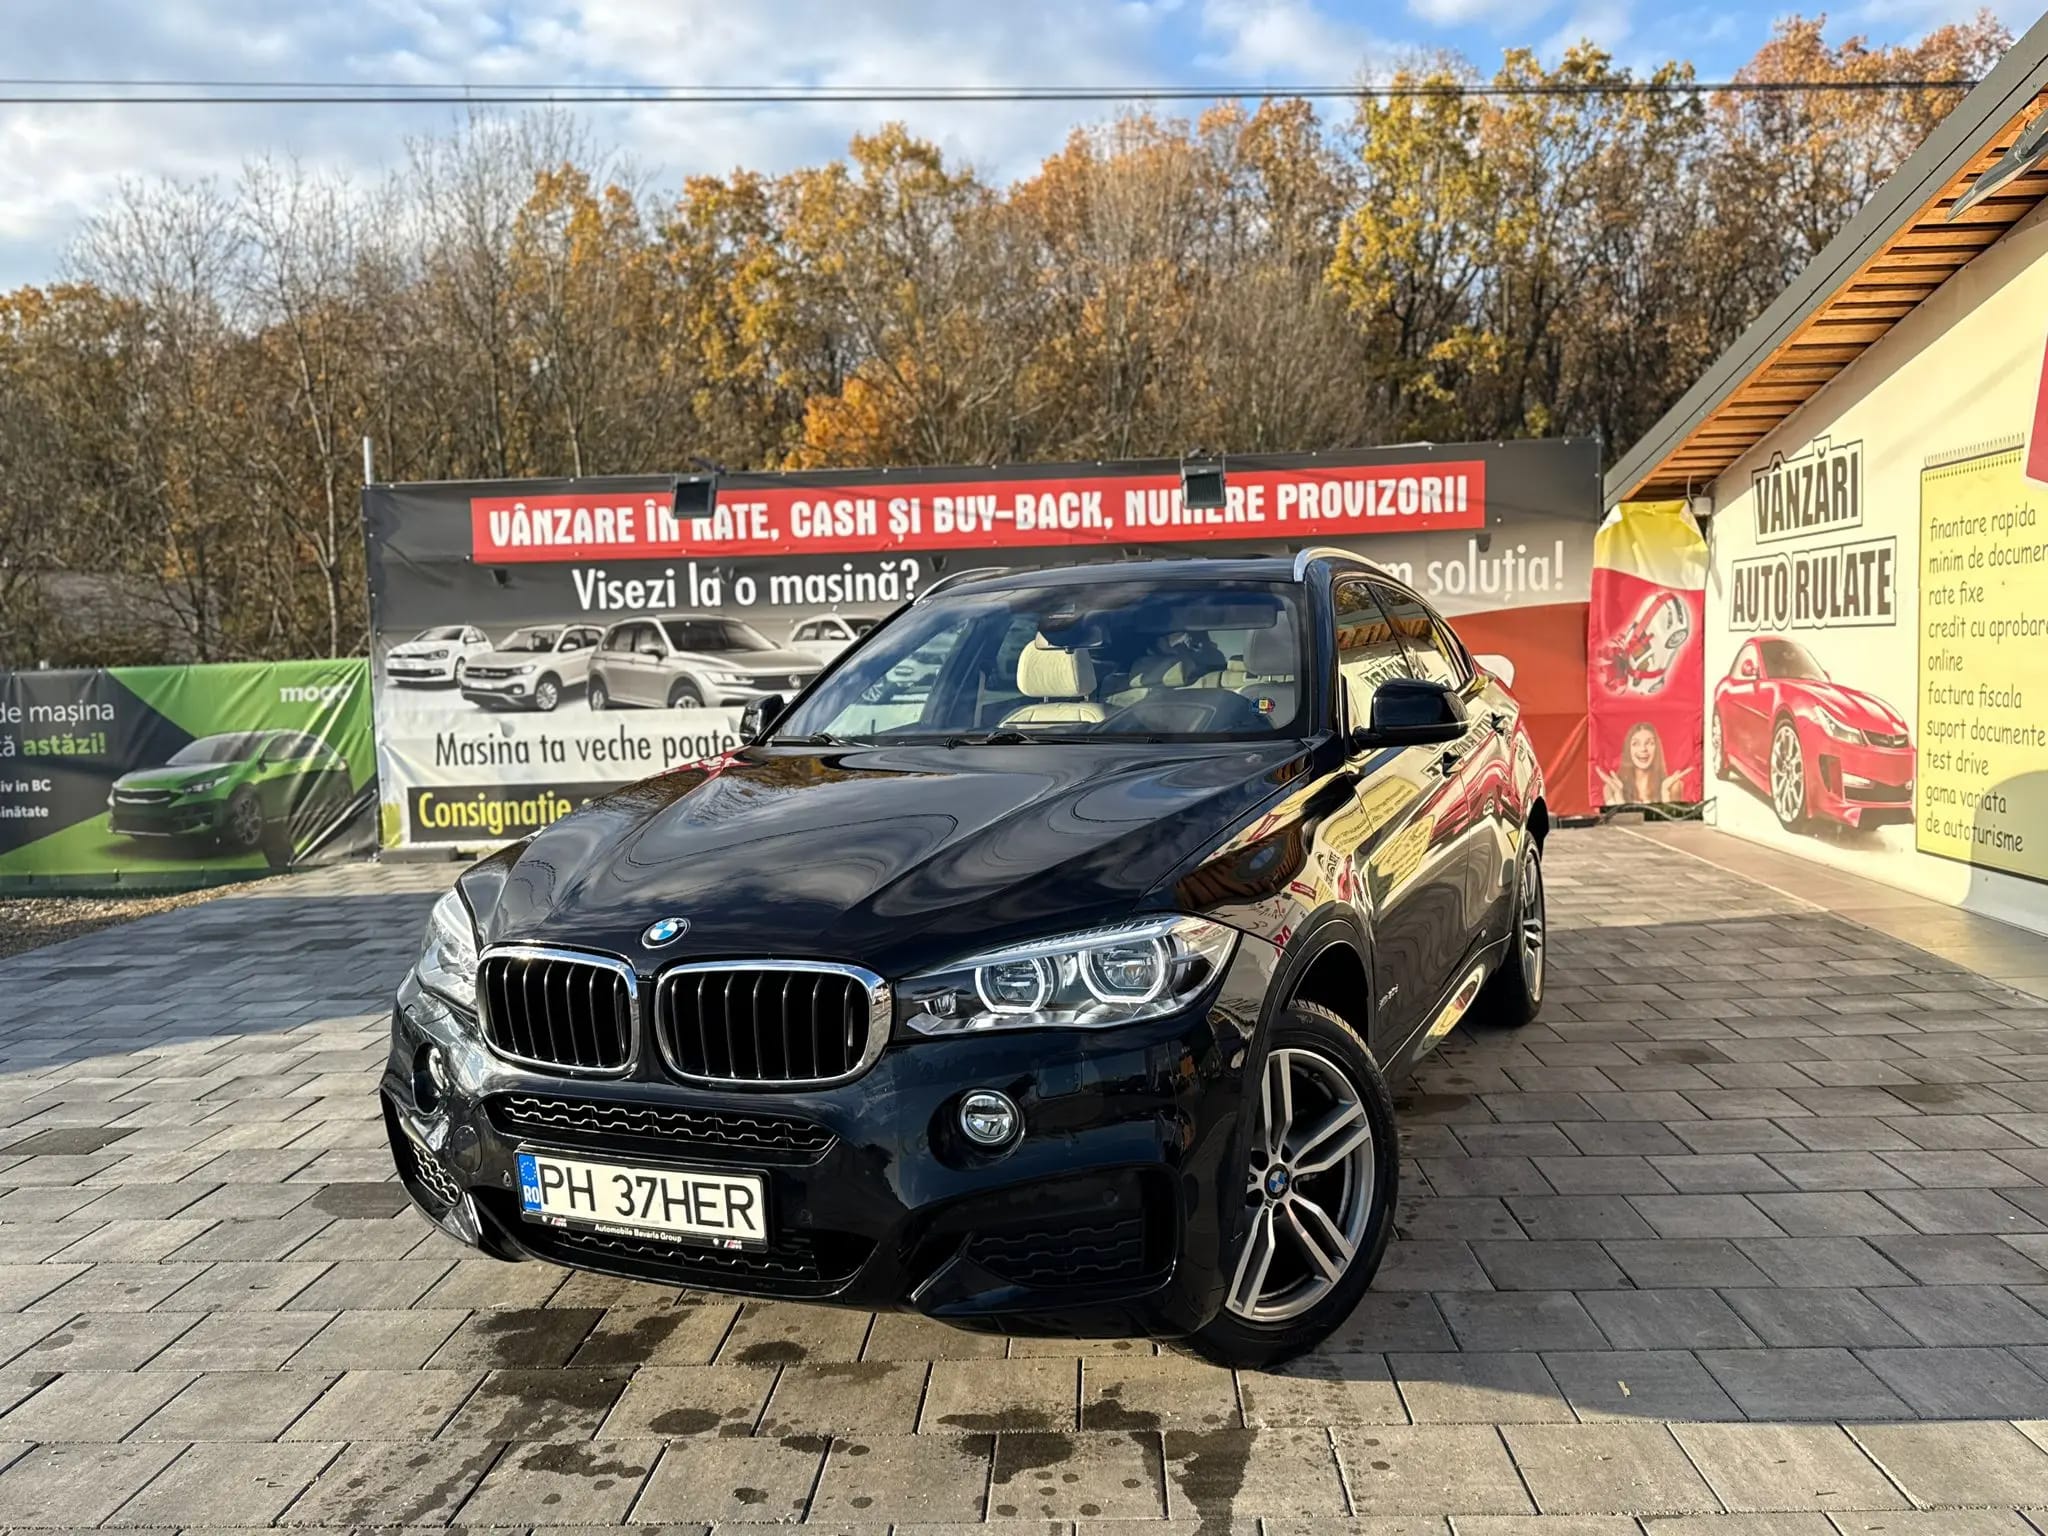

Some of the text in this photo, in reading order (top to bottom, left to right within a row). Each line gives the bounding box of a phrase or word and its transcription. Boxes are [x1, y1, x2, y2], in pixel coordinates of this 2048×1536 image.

[1755, 447, 1858, 535] VÂNZĂRI
[489, 502, 635, 546] VÂNZARE
[645, 499, 681, 542] ÎN
[790, 499, 877, 538] CASH
[888, 498, 921, 543] ȘI
[1277, 475, 1467, 520] PROVIZORII
[1930, 502, 2036, 543] finantare rapida
[1427, 539, 1564, 602] soluția!
[1928, 550, 1964, 574] minim
[1968, 546, 1984, 569] de
[572, 568, 676, 610] Visezi
[689, 562, 721, 608] la
[735, 577, 757, 606] o
[1733, 548, 1891, 623] AUTO RULATE
[1928, 581, 1984, 606] rate fixe
[1928, 616, 1966, 639] credit
[1970, 620, 1985, 637] cu
[1928, 649, 1964, 672] online
[1928, 681, 2022, 709] factura fiscala
[29, 699, 115, 727] mașina
[23, 732, 106, 756] astăzi!
[540, 735, 565, 763] ta
[576, 724, 651, 761] veche
[663, 729, 735, 768] poate
[1926, 717, 2046, 747] suport documente
[1926, 749, 1989, 776] test drive
[31, 779, 52, 792] BC
[1926, 785, 2007, 814] gama variata
[0, 806, 49, 818] inătate
[1926, 811, 2024, 852] de autoturisme
[524, 1186, 540, 1204] RO
[538, 1163, 756, 1231] PH 37HER
